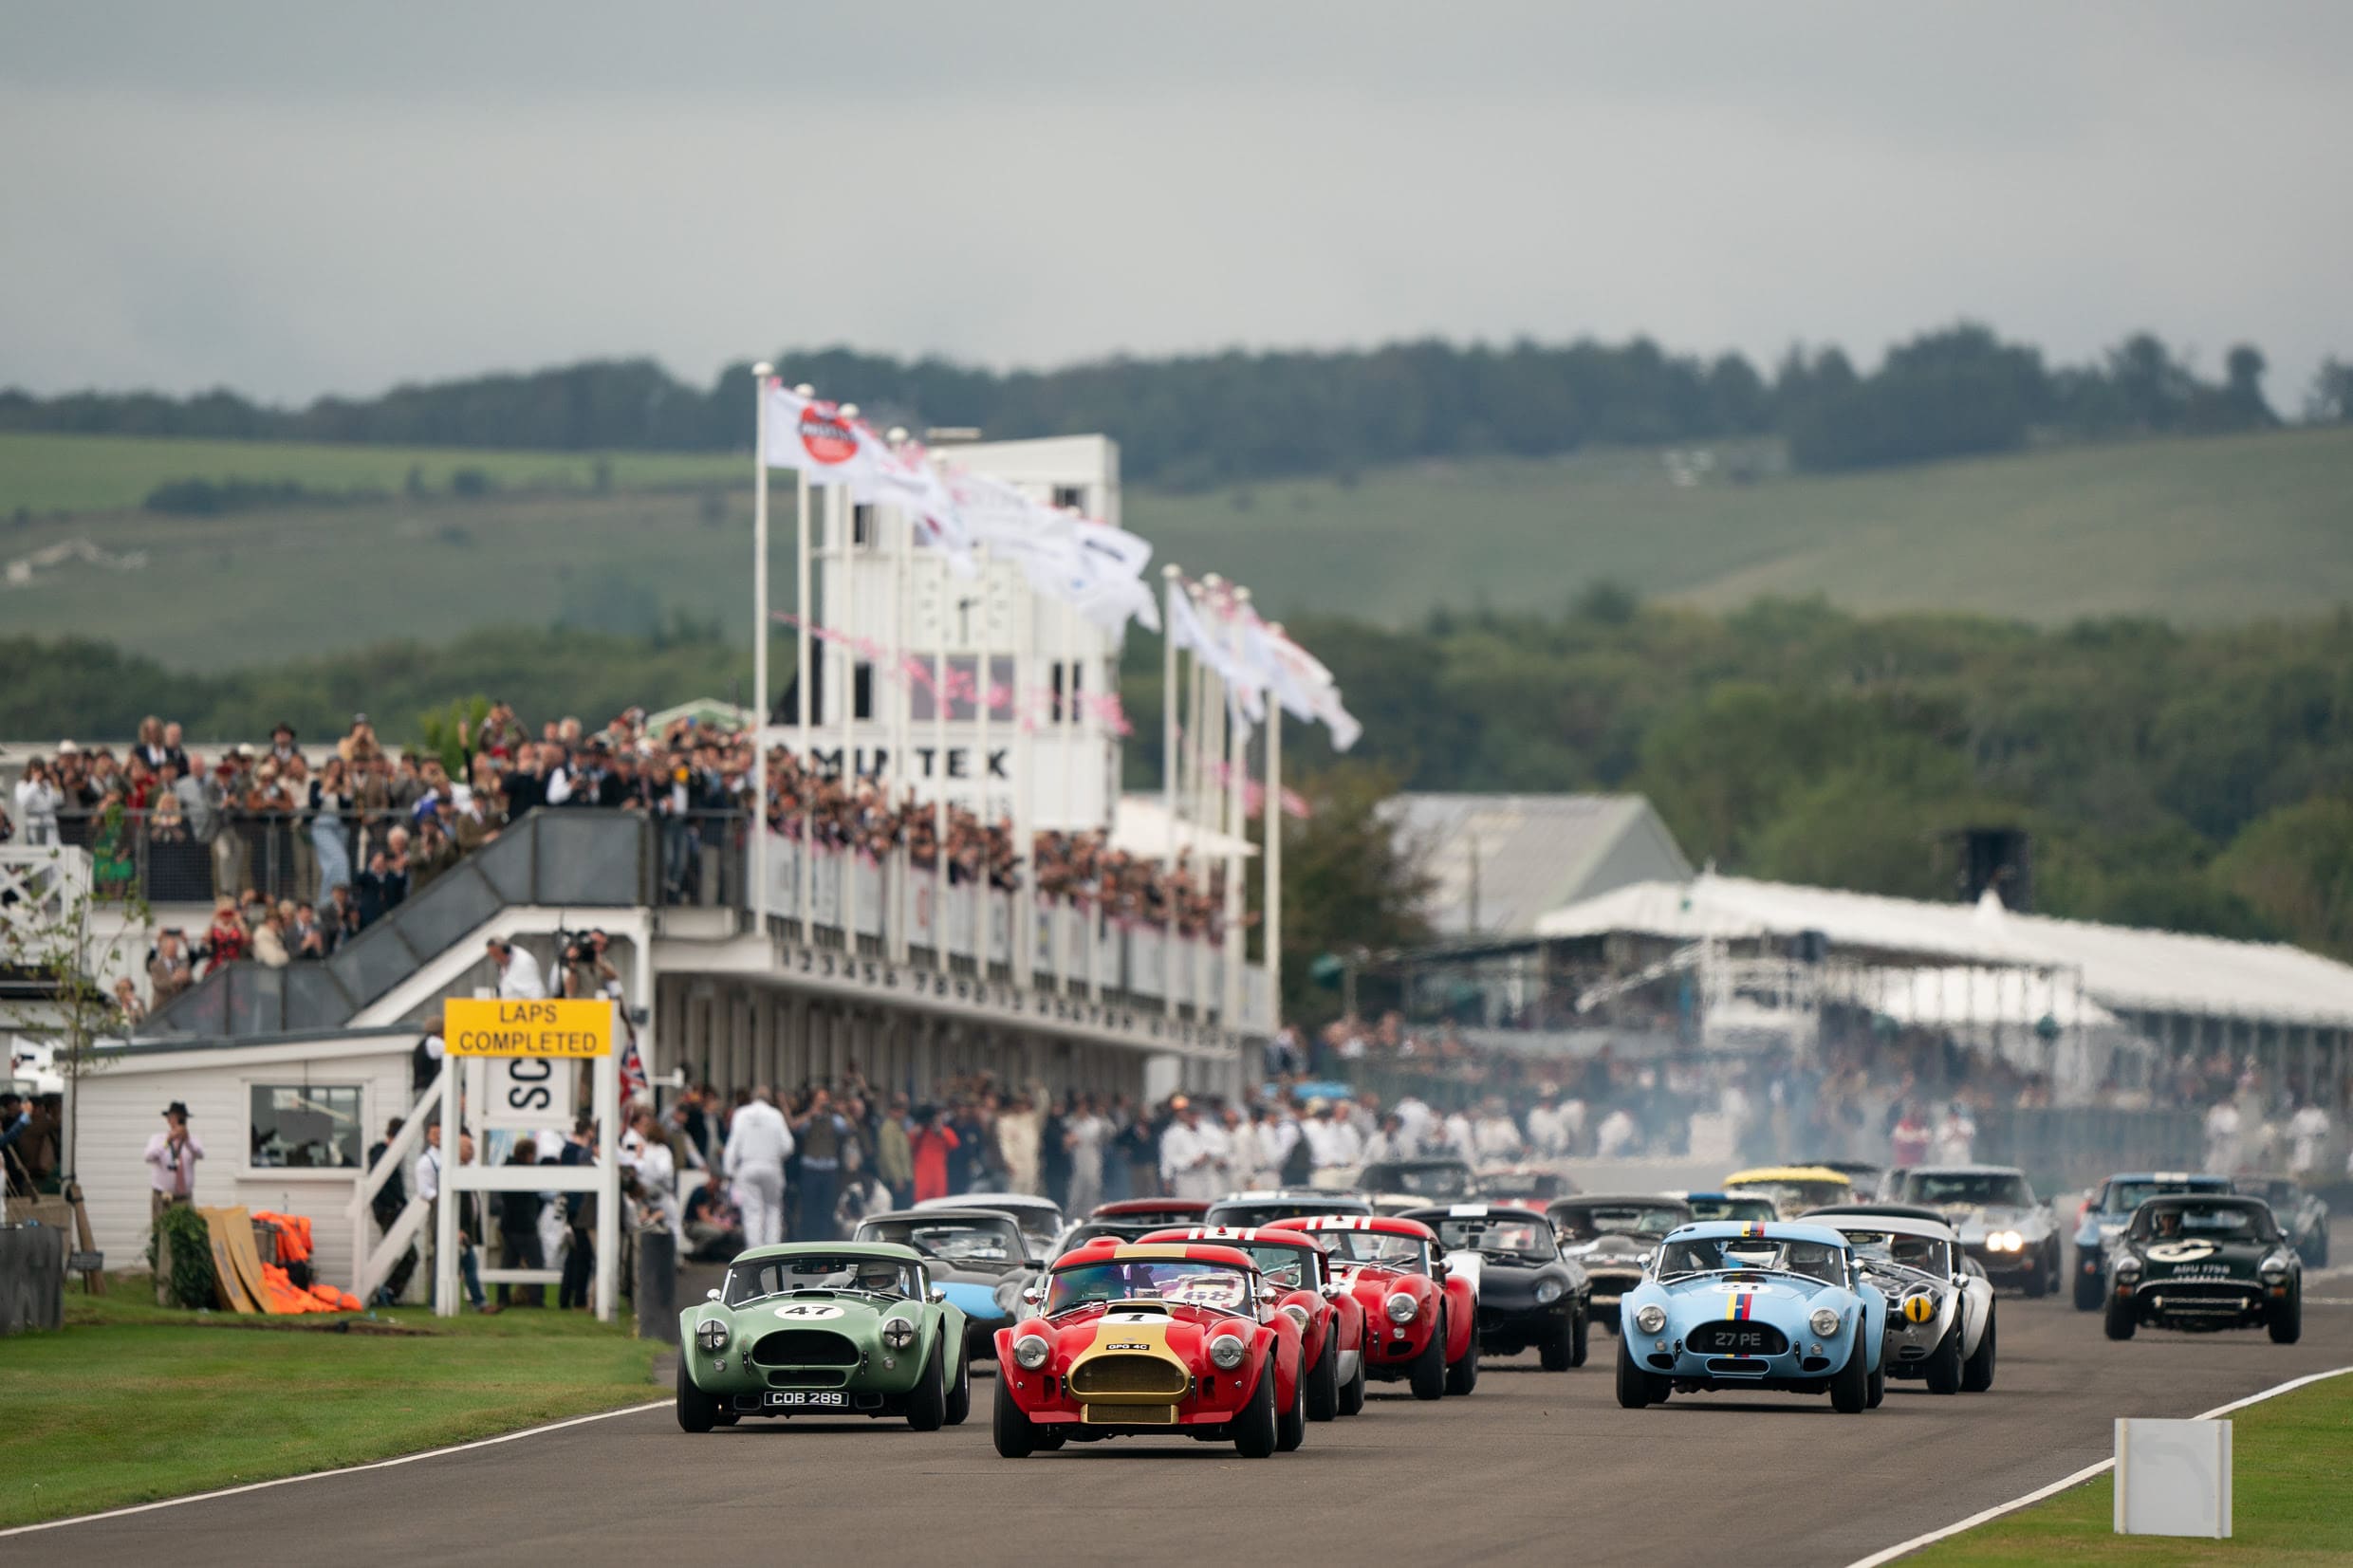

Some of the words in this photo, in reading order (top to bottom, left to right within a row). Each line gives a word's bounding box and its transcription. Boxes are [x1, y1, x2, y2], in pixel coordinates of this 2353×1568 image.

[499, 1004, 558, 1024] LAPS
[459, 1031, 597, 1052] COMPLETED
[508, 1057, 551, 1111] SC
[785, 1306, 836, 1316] 47
[1124, 1314, 1146, 1322] 1
[1714, 1332, 1736, 1346] 27
[1739, 1332, 1762, 1346] PE
[772, 1393, 806, 1404] COB
[809, 1393, 843, 1405] 289
